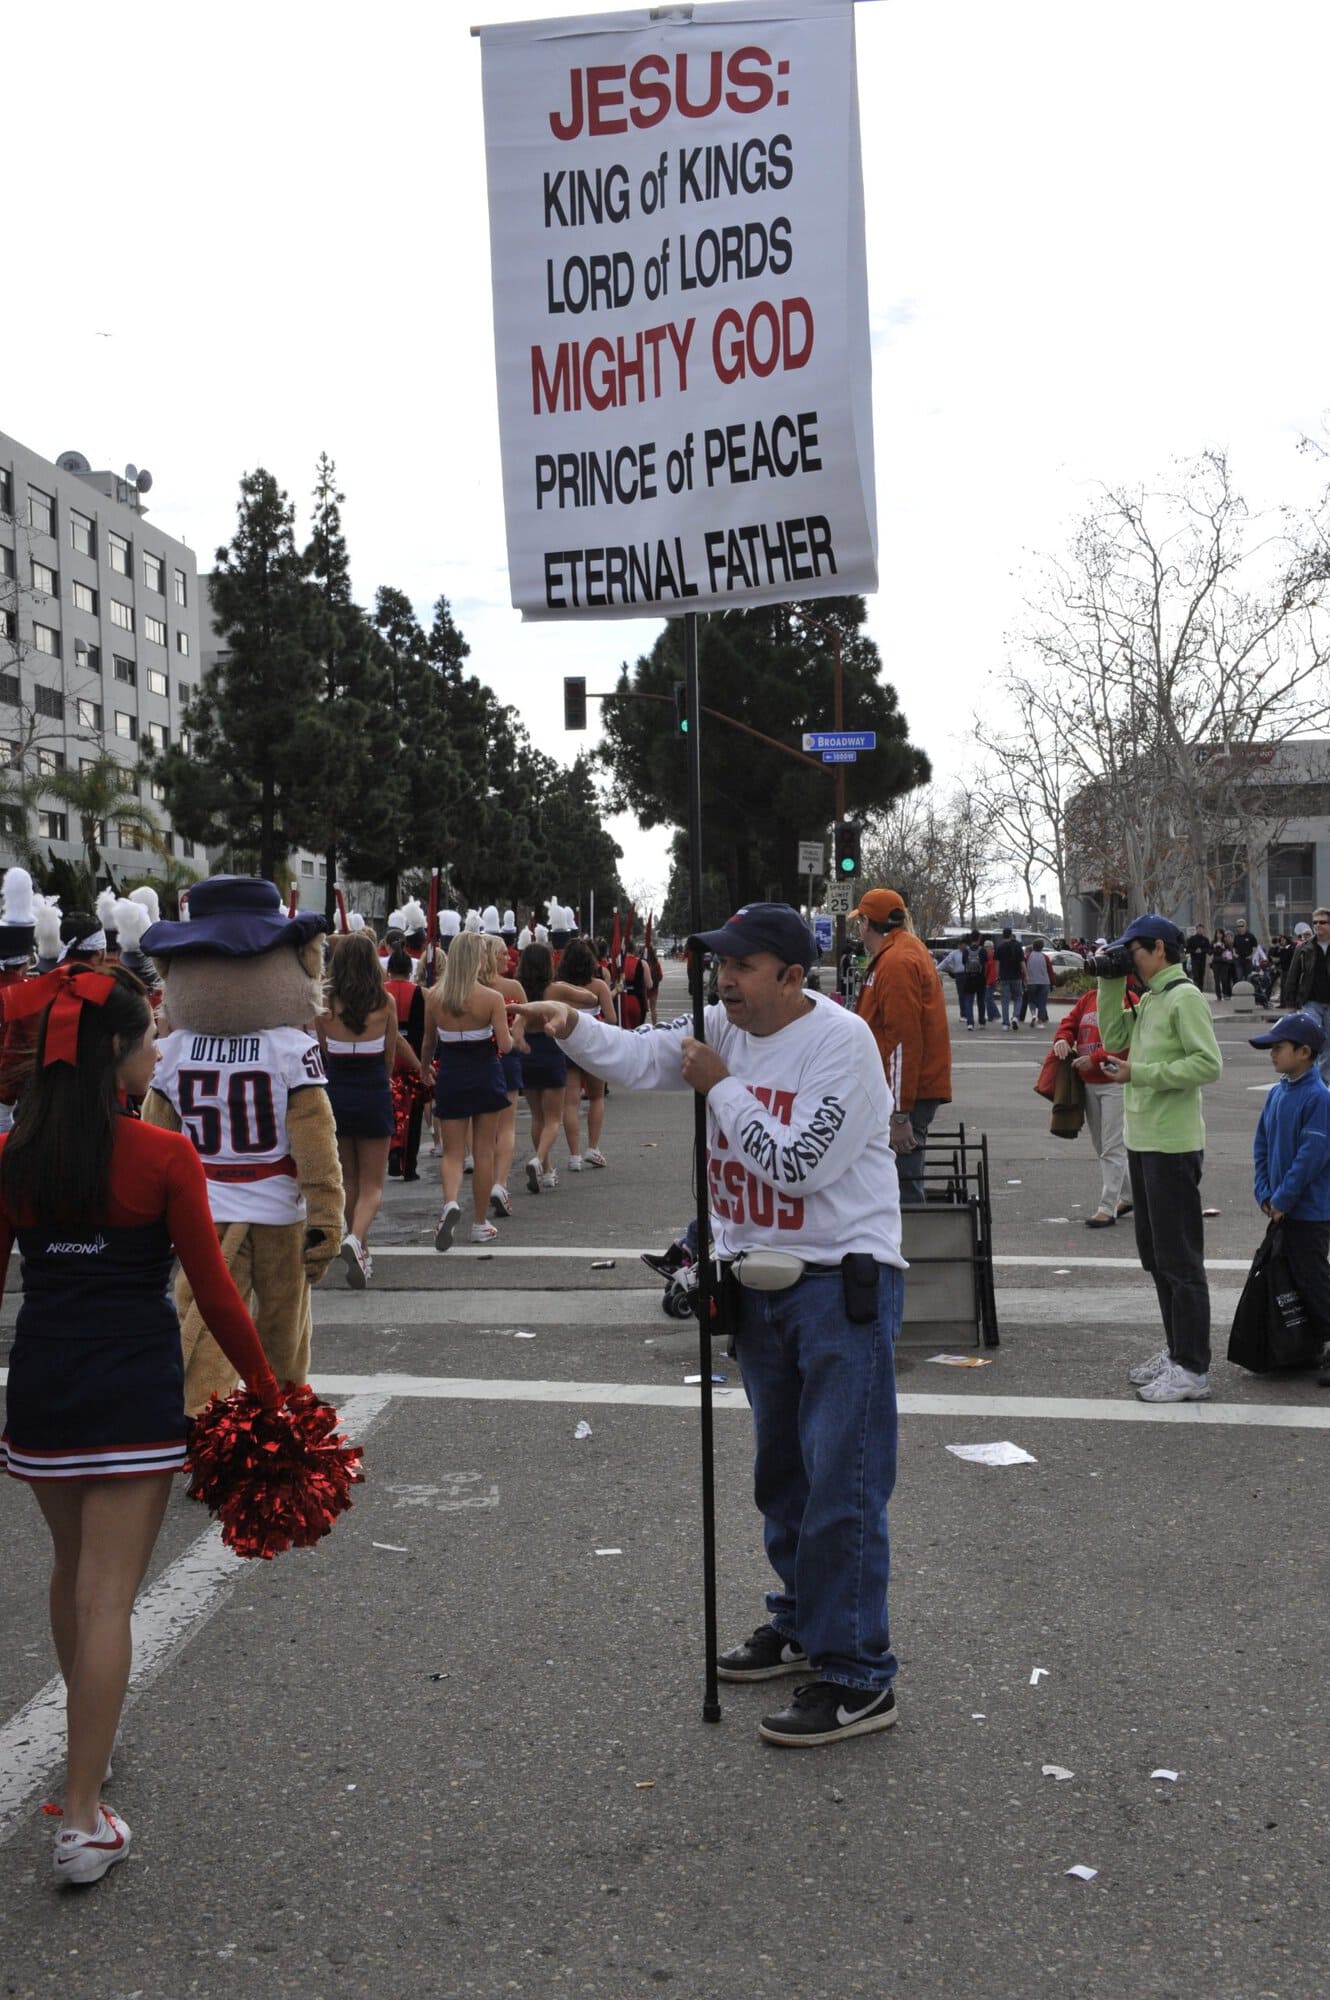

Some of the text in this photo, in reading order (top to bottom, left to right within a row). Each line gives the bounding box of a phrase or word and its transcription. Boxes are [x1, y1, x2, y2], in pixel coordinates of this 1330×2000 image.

[549, 46, 790, 141] JESUS:
[544, 133, 793, 228] KING of KINGS
[546, 216, 793, 314] LORD of LORDS
[531, 297, 815, 415] MIGHTY GOD
[536, 411, 823, 510] PRINCE of PEACE
[544, 514, 838, 609] ETERNAL FATHER
[817, 736, 865, 747] BROADWAY
[831, 899, 849, 911] 25
[191, 1037, 260, 1063] WILBUR
[178, 1070, 278, 1155] 50
[707, 1154, 805, 1230] ESUS
[46, 1243, 99, 1255] ARIZONA
